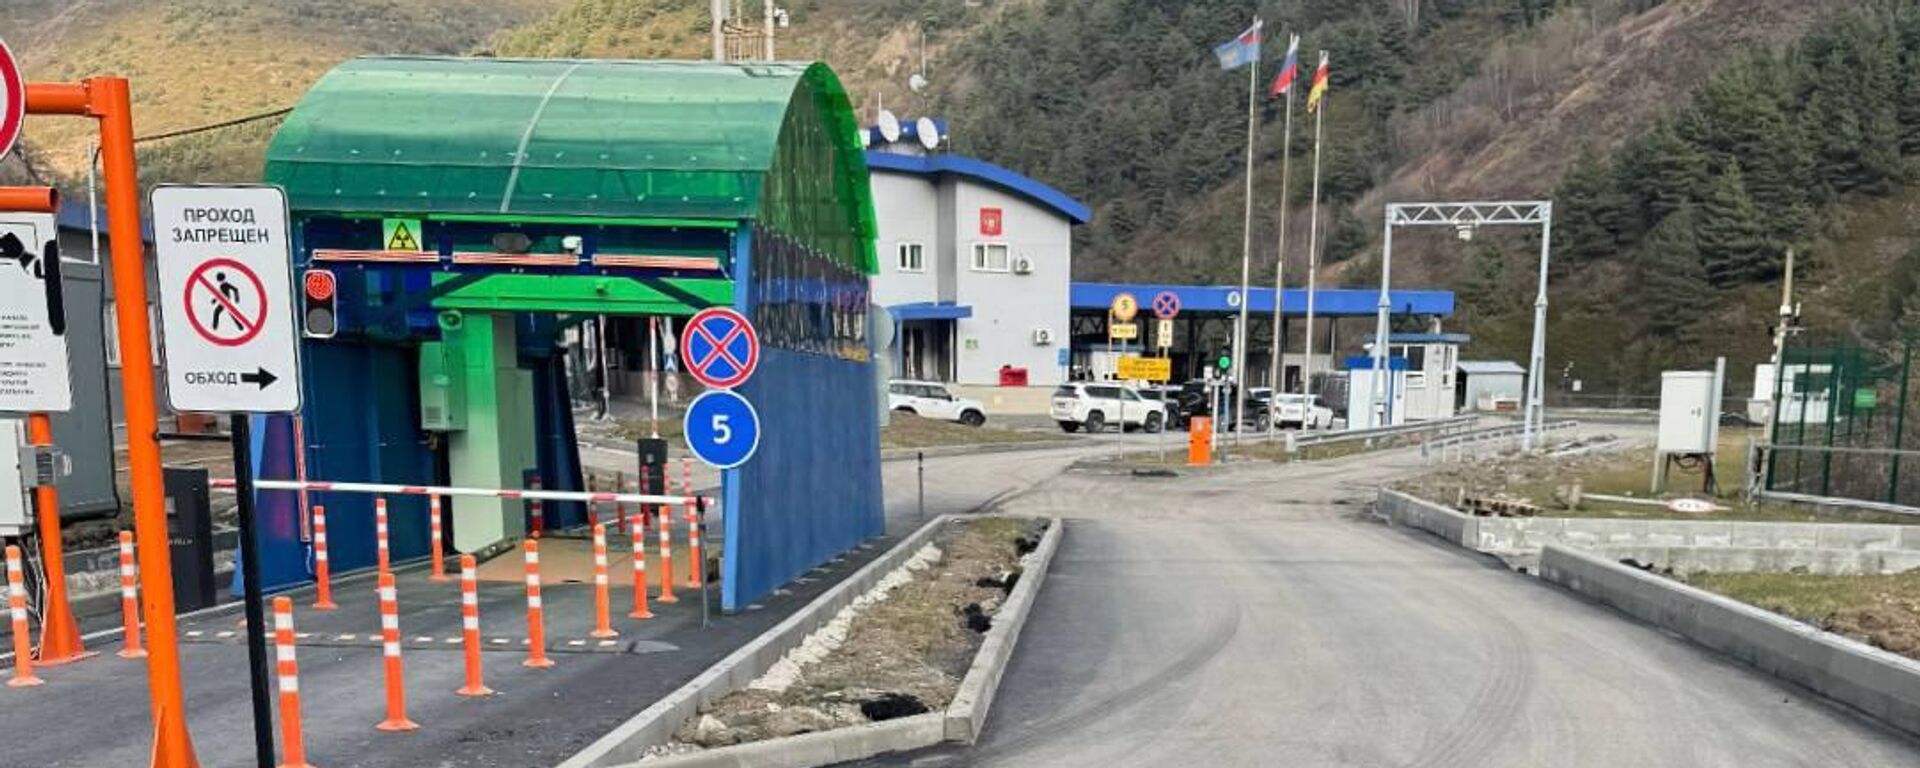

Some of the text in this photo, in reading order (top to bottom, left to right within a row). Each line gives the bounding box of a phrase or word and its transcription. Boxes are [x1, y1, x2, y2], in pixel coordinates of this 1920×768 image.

[183, 208, 256, 224] ПРОХОД
[172, 228, 270, 244] ЗАПРЕЩЕН
[184, 371, 238, 386] ОБХОД
[711, 414, 732, 445] 5
